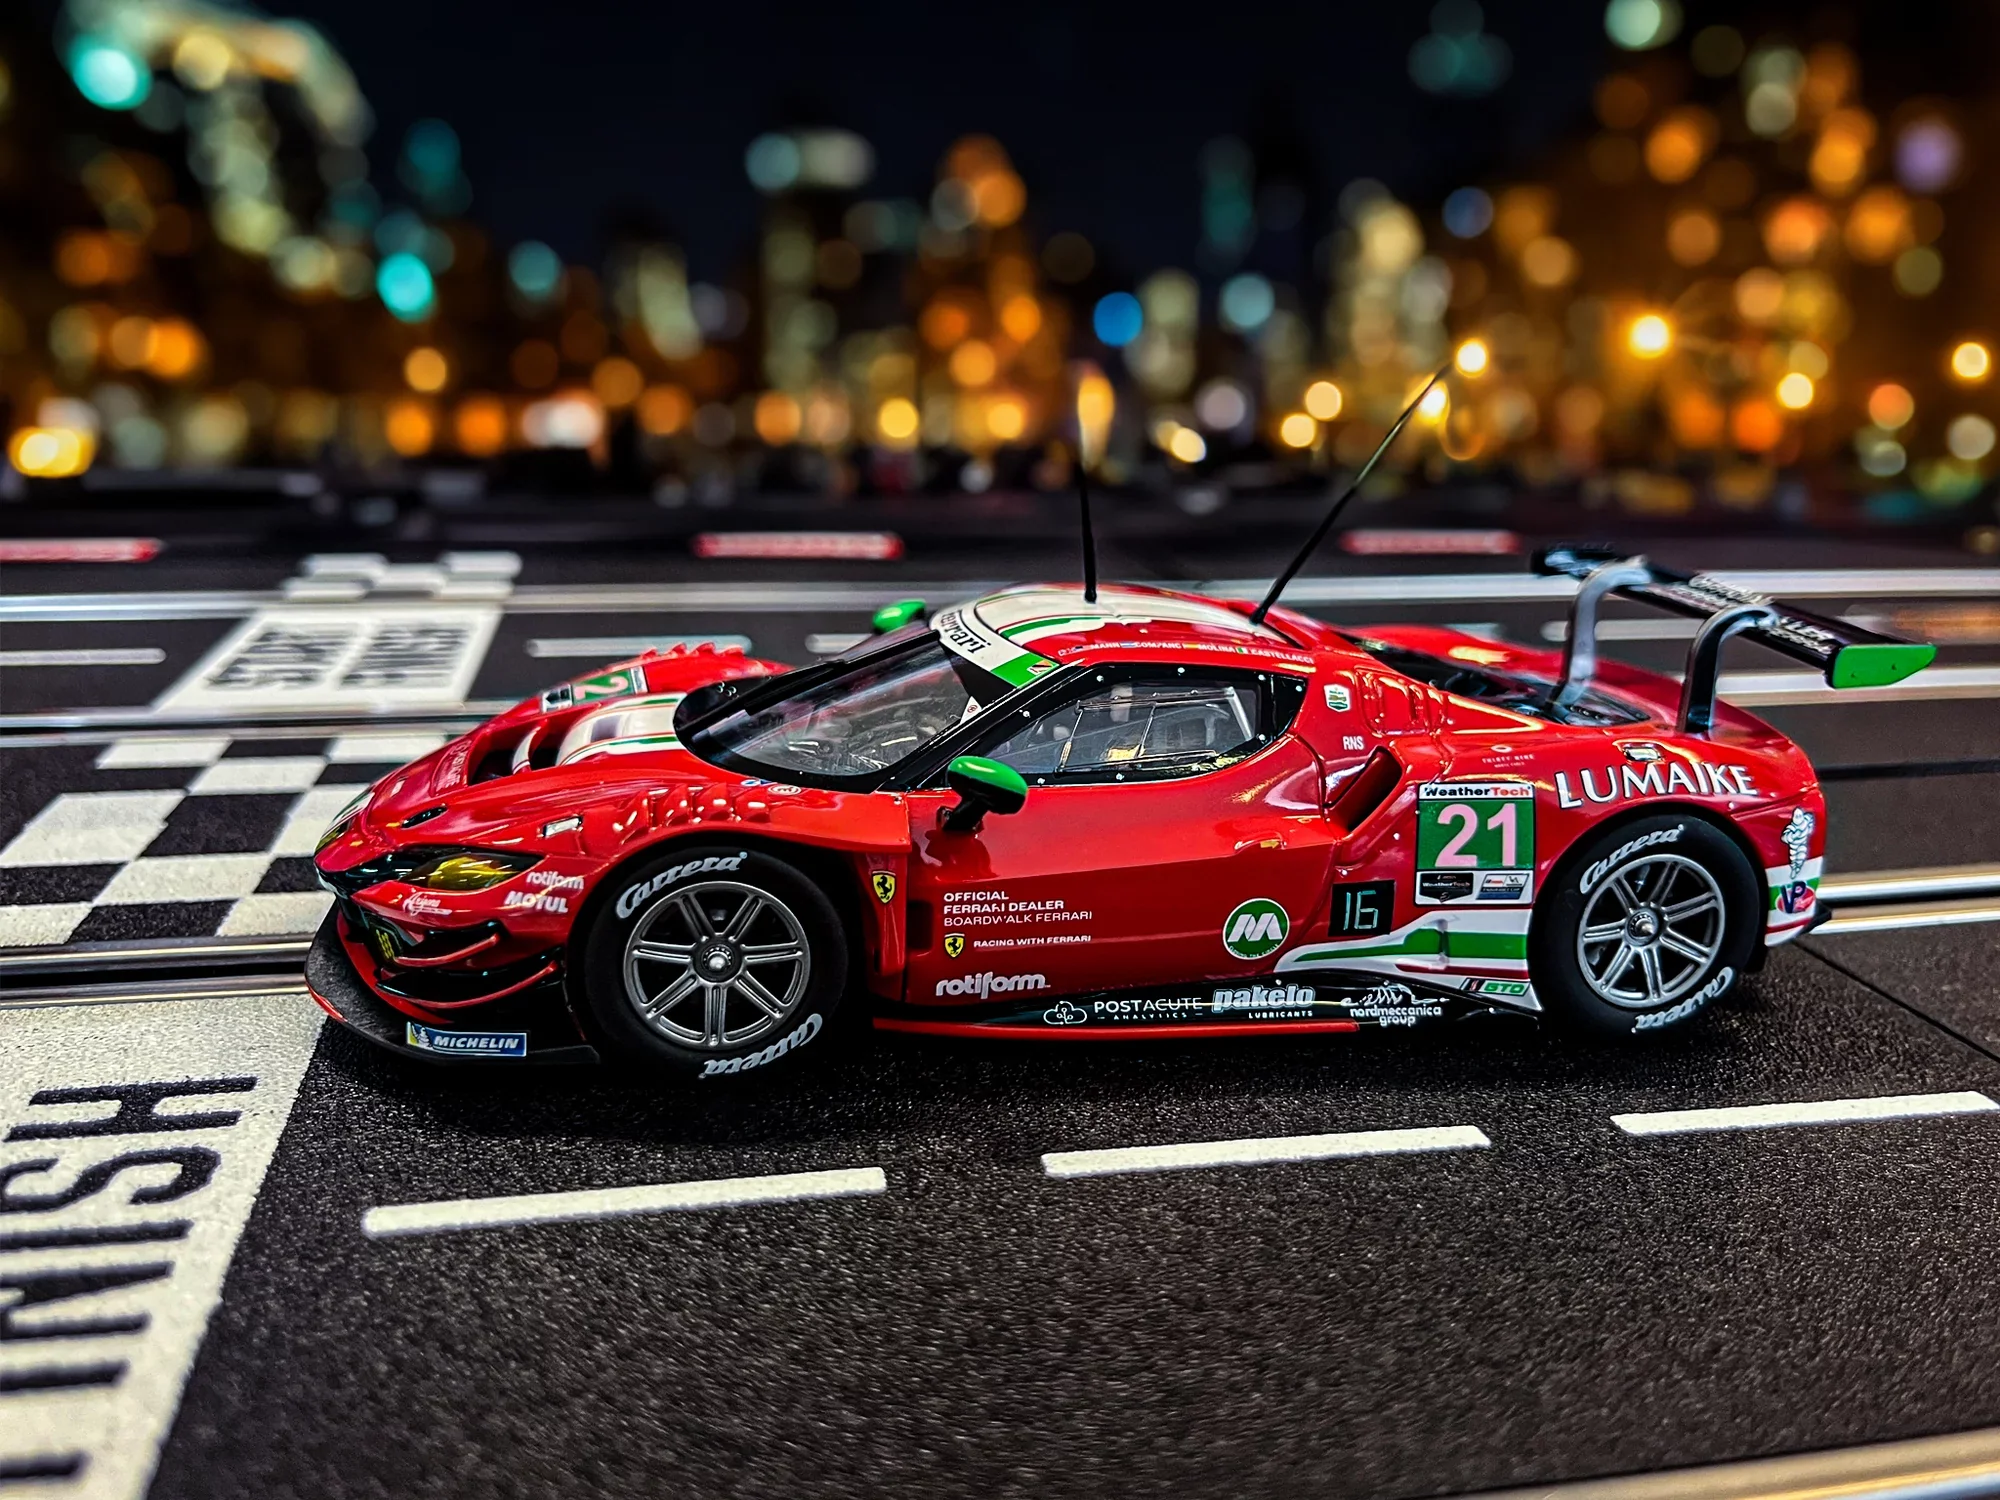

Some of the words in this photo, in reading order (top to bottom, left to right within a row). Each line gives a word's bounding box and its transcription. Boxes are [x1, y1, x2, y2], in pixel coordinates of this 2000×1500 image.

[1198, 643, 1235, 654] MOLINA
[1343, 735, 1364, 751] RNS
[1425, 786, 1530, 797] WeatherTech
[1555, 762, 1759, 808] LUMAIKE
[1435, 803, 1516, 868] 21
[1579, 824, 1684, 894] Carrera
[526, 871, 584, 889] rotiform
[616, 852, 747, 919] Carrera
[504, 891, 568, 913] MOTUL
[944, 891, 1009, 902] OFFICIAL
[1781, 881, 1806, 913] VP
[1008, 900, 1064, 912] DEALER
[1344, 890, 1380, 930] 16
[1036, 911, 1092, 922] FERRARI
[974, 939, 1015, 948] RACING
[1017, 937, 1044, 946] WITH
[1047, 935, 1091, 944] FERRARI
[1094, 998, 1202, 1013] POSTACUTE
[1212, 984, 1316, 1012] pakelo
[1249, 1010, 1313, 1019] LUBRICANTS
[1350, 1003, 1442, 1017] nordmeccanica
[1379, 1015, 1416, 1027] group
[434, 1035, 519, 1049] MICHELIN
[699, 1013, 823, 1078] Carrera
